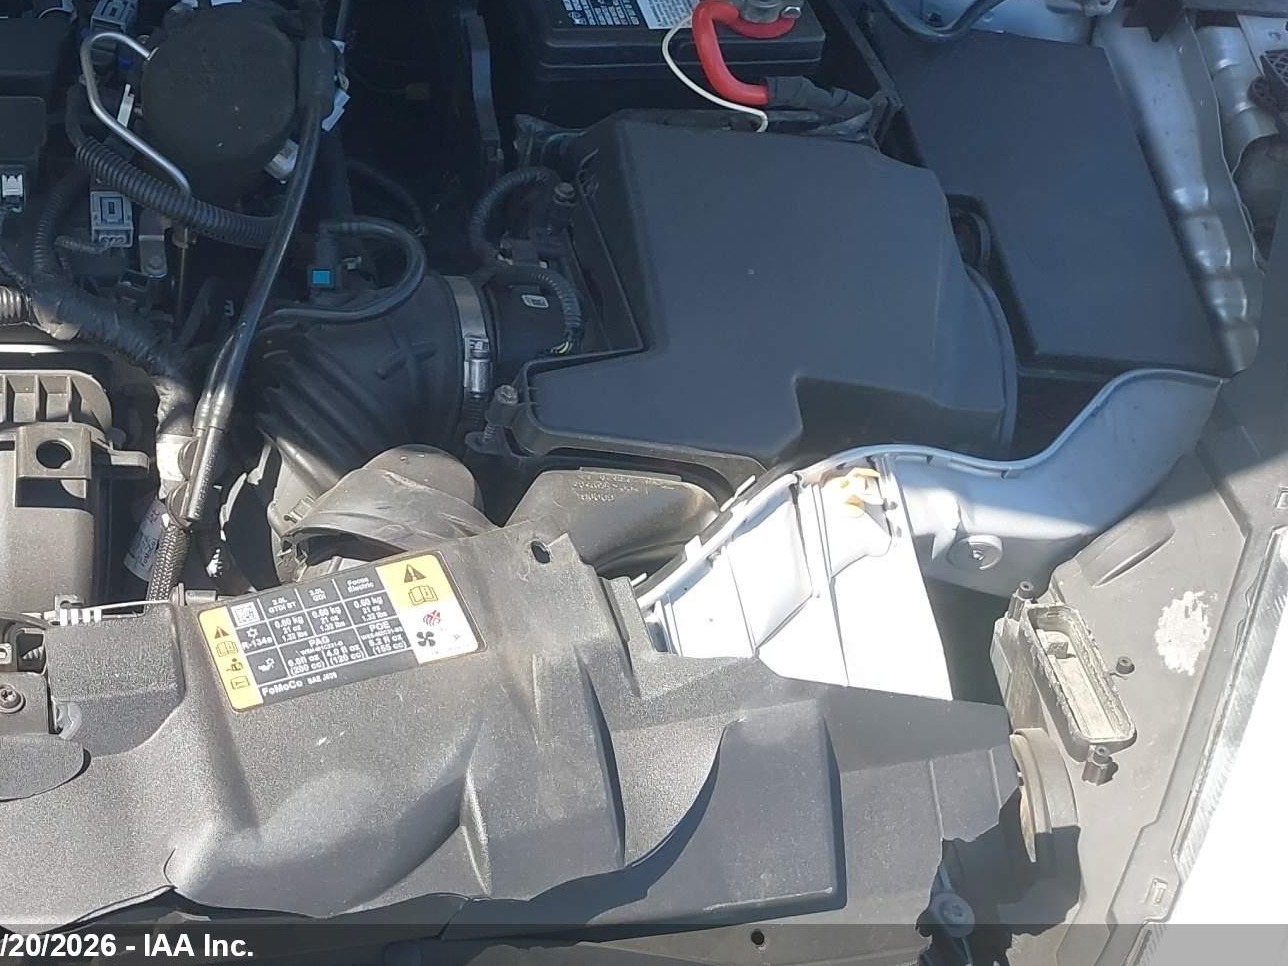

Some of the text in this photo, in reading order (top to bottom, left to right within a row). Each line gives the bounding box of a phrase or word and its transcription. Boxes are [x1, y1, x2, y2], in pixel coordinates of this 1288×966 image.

[354, 598, 371, 608] 0.60
[329, 606, 341, 614] kg
[292, 616, 304, 626] kg
[369, 621, 390, 632] POE
[283, 626, 291, 634] 21
[242, 637, 272, 650] R-134a
[309, 636, 330, 647] PAG
[393, 640, 407, 651] cc)
[327, 648, 339, 657] 4.0
[330, 650, 364, 665] (120 cc)
[291, 660, 325, 675] (200 cc)
[262, 680, 303, 696] FoMoCo
